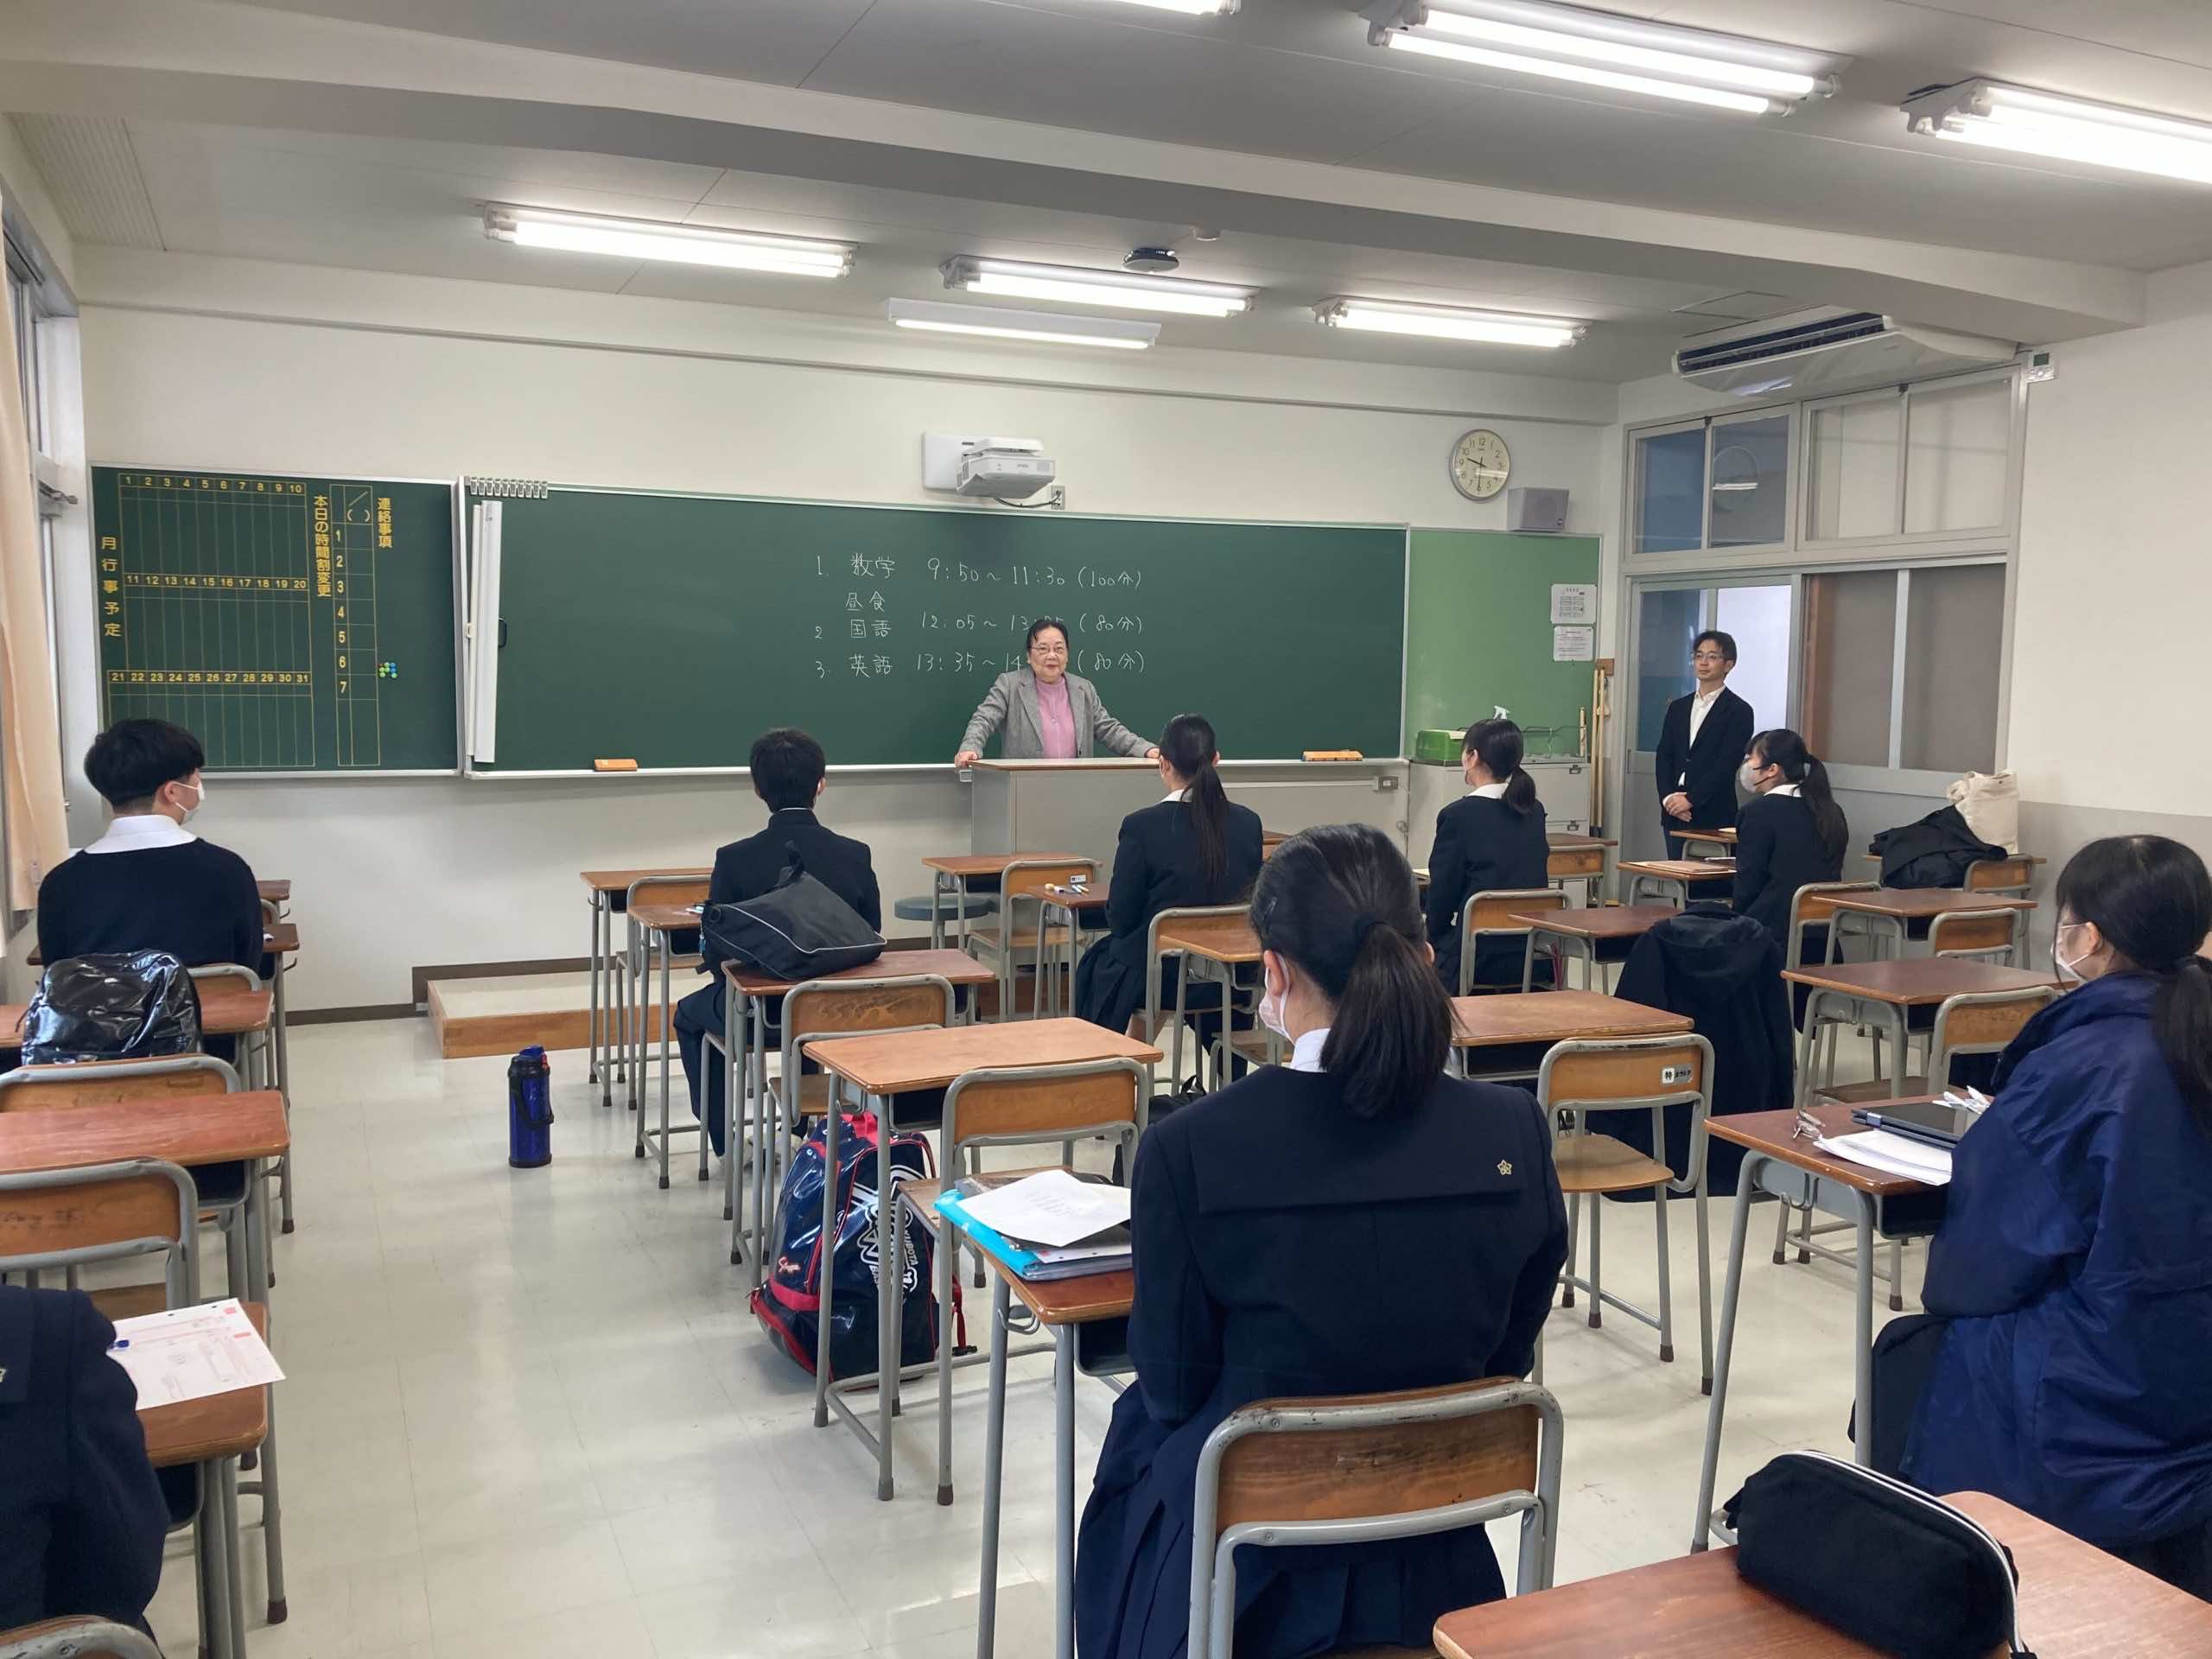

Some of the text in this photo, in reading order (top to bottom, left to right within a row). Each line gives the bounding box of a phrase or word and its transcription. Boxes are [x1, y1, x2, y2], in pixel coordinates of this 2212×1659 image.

[1478, 436, 1485, 446] 12
[125, 476, 302, 493] 1 2 3 4 5 6 7 8 9 10
[378, 497, 393, 549] 連絡事項
[336, 530, 341, 543] 1
[314, 494, 332, 598] 本日の時間割変更
[337, 555, 344, 568] 2
[850, 553, 896, 579] 数学
[101, 536, 122, 637] 月行事予定
[146, 575, 159, 585] 12
[165, 576, 177, 585] 13
[203, 577, 215, 586] 15
[221, 578, 233, 587] 16
[257, 579, 270, 588] 18
[276, 580, 288, 588] 19
[294, 580, 306, 588] 20
[338, 580, 345, 594] 3
[845, 590, 886, 613] 昼食
[338, 606, 345, 618] 4
[850, 619, 892, 639] 国語
[339, 631, 346, 644] 5
[340, 656, 346, 668] 6
[849, 653, 893, 677] 英語
[111, 672, 124, 681] 21
[207, 673, 219, 682] 26
[225, 673, 237, 682] 27
[243, 673, 256, 682] 28
[261, 673, 274, 682] 29
[296, 674, 308, 683] 31
[340, 681, 346, 693] 7
